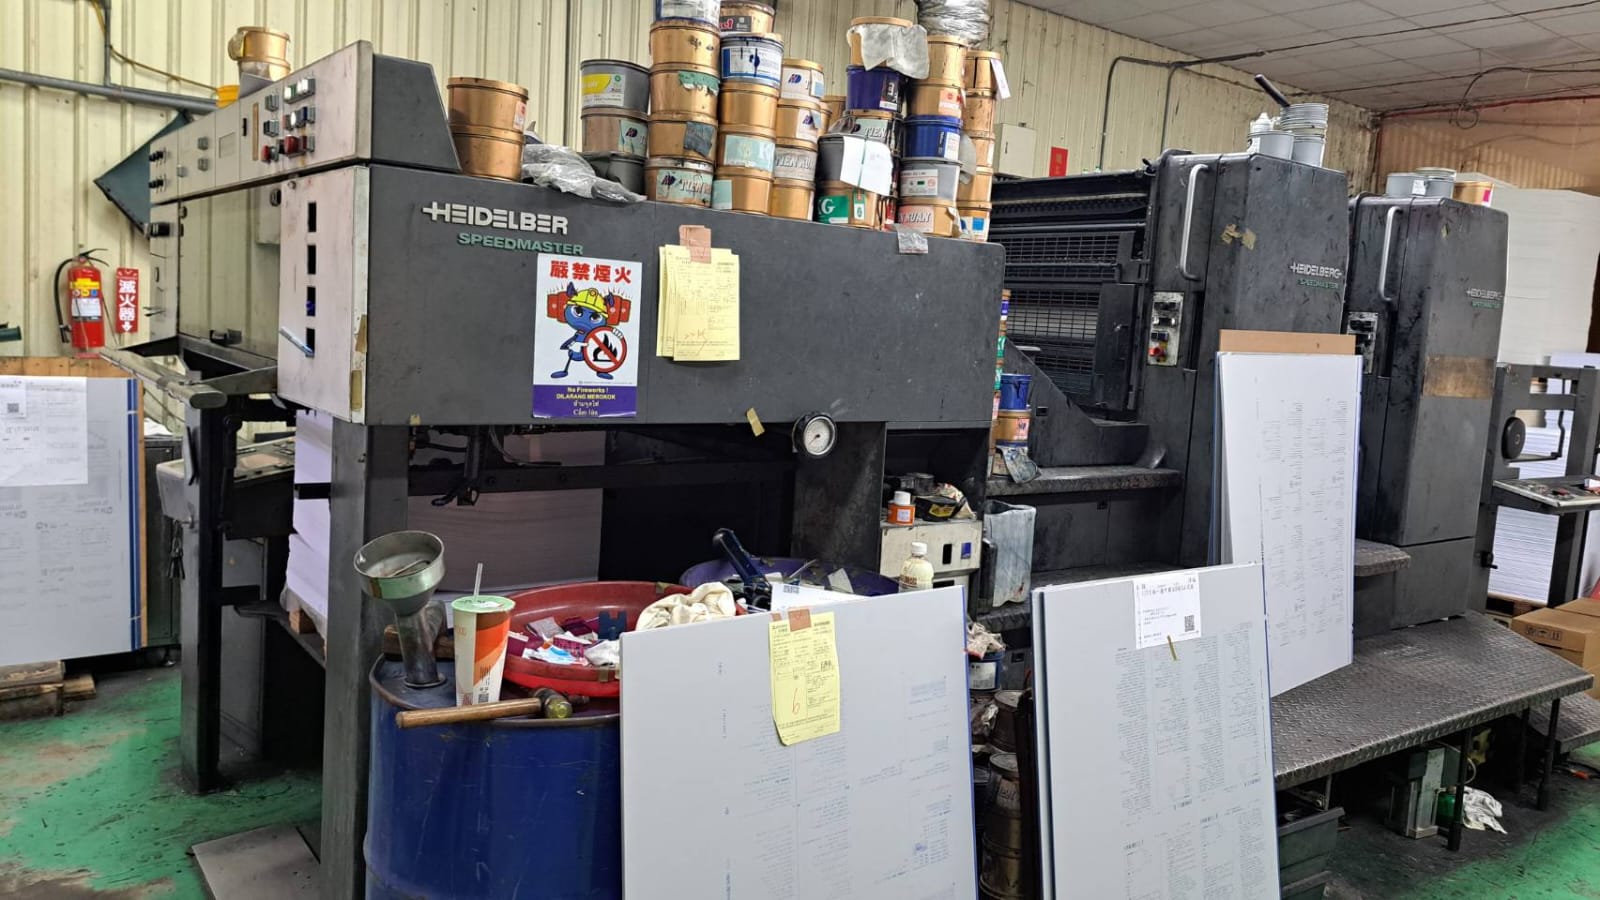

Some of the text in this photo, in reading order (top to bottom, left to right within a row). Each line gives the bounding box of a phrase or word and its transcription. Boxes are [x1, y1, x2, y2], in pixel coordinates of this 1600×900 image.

[421, 201, 569, 235] HEIDELBER
[458, 232, 584, 255] SPEEDMASTER
[1289, 261, 1343, 279] HEIDELBERG
[118, 279, 136, 321] 滅火器
